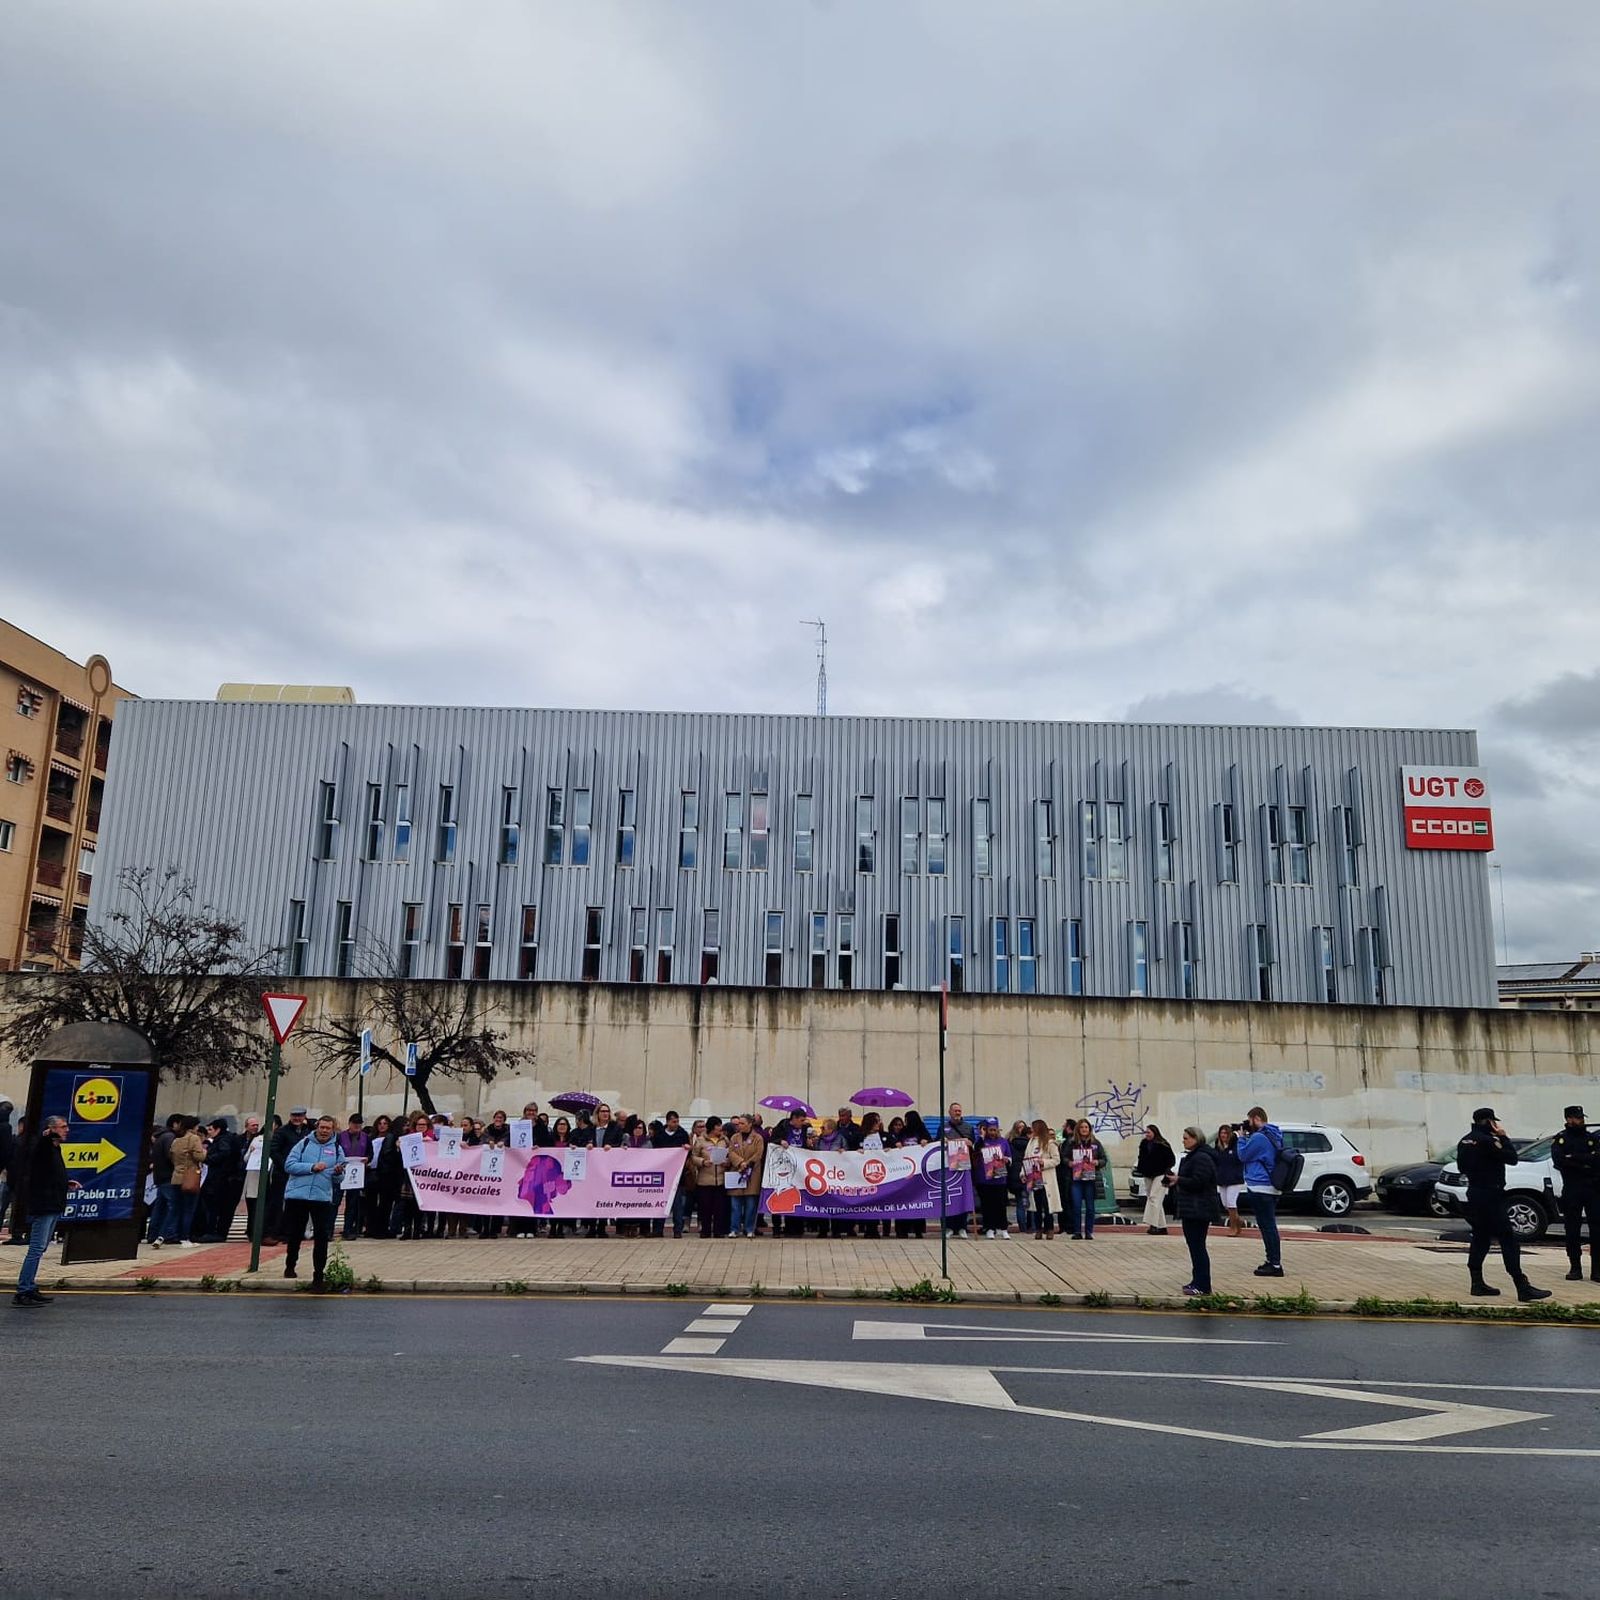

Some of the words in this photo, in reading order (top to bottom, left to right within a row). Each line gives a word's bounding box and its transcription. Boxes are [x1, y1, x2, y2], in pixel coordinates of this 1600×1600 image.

[1408, 776, 1459, 797] UGT
[1411, 819, 1473, 835] CCOO
[68, 1152, 75, 1161] 2
[79, 1152, 99, 1161] KM
[613, 1174, 652, 1185] CCOO
[804, 1158, 826, 1196] 8
[826, 1166, 846, 1180] de
[77, 1189, 105, 1200] Pablo
[120, 1188, 131, 1198] 23
[416, 1182, 451, 1192] orales
[451, 1186, 459, 1195] y
[459, 1185, 501, 1196] sociales
[827, 1185, 878, 1197] marzo
[81, 1204, 98, 1213] 110
[804, 1204, 818, 1213] DIA
[819, 1203, 883, 1215] INTERNACIONAL
[884, 1204, 896, 1212] DE
[896, 1203, 907, 1211] LA
[908, 1201, 934, 1210] MUJER
